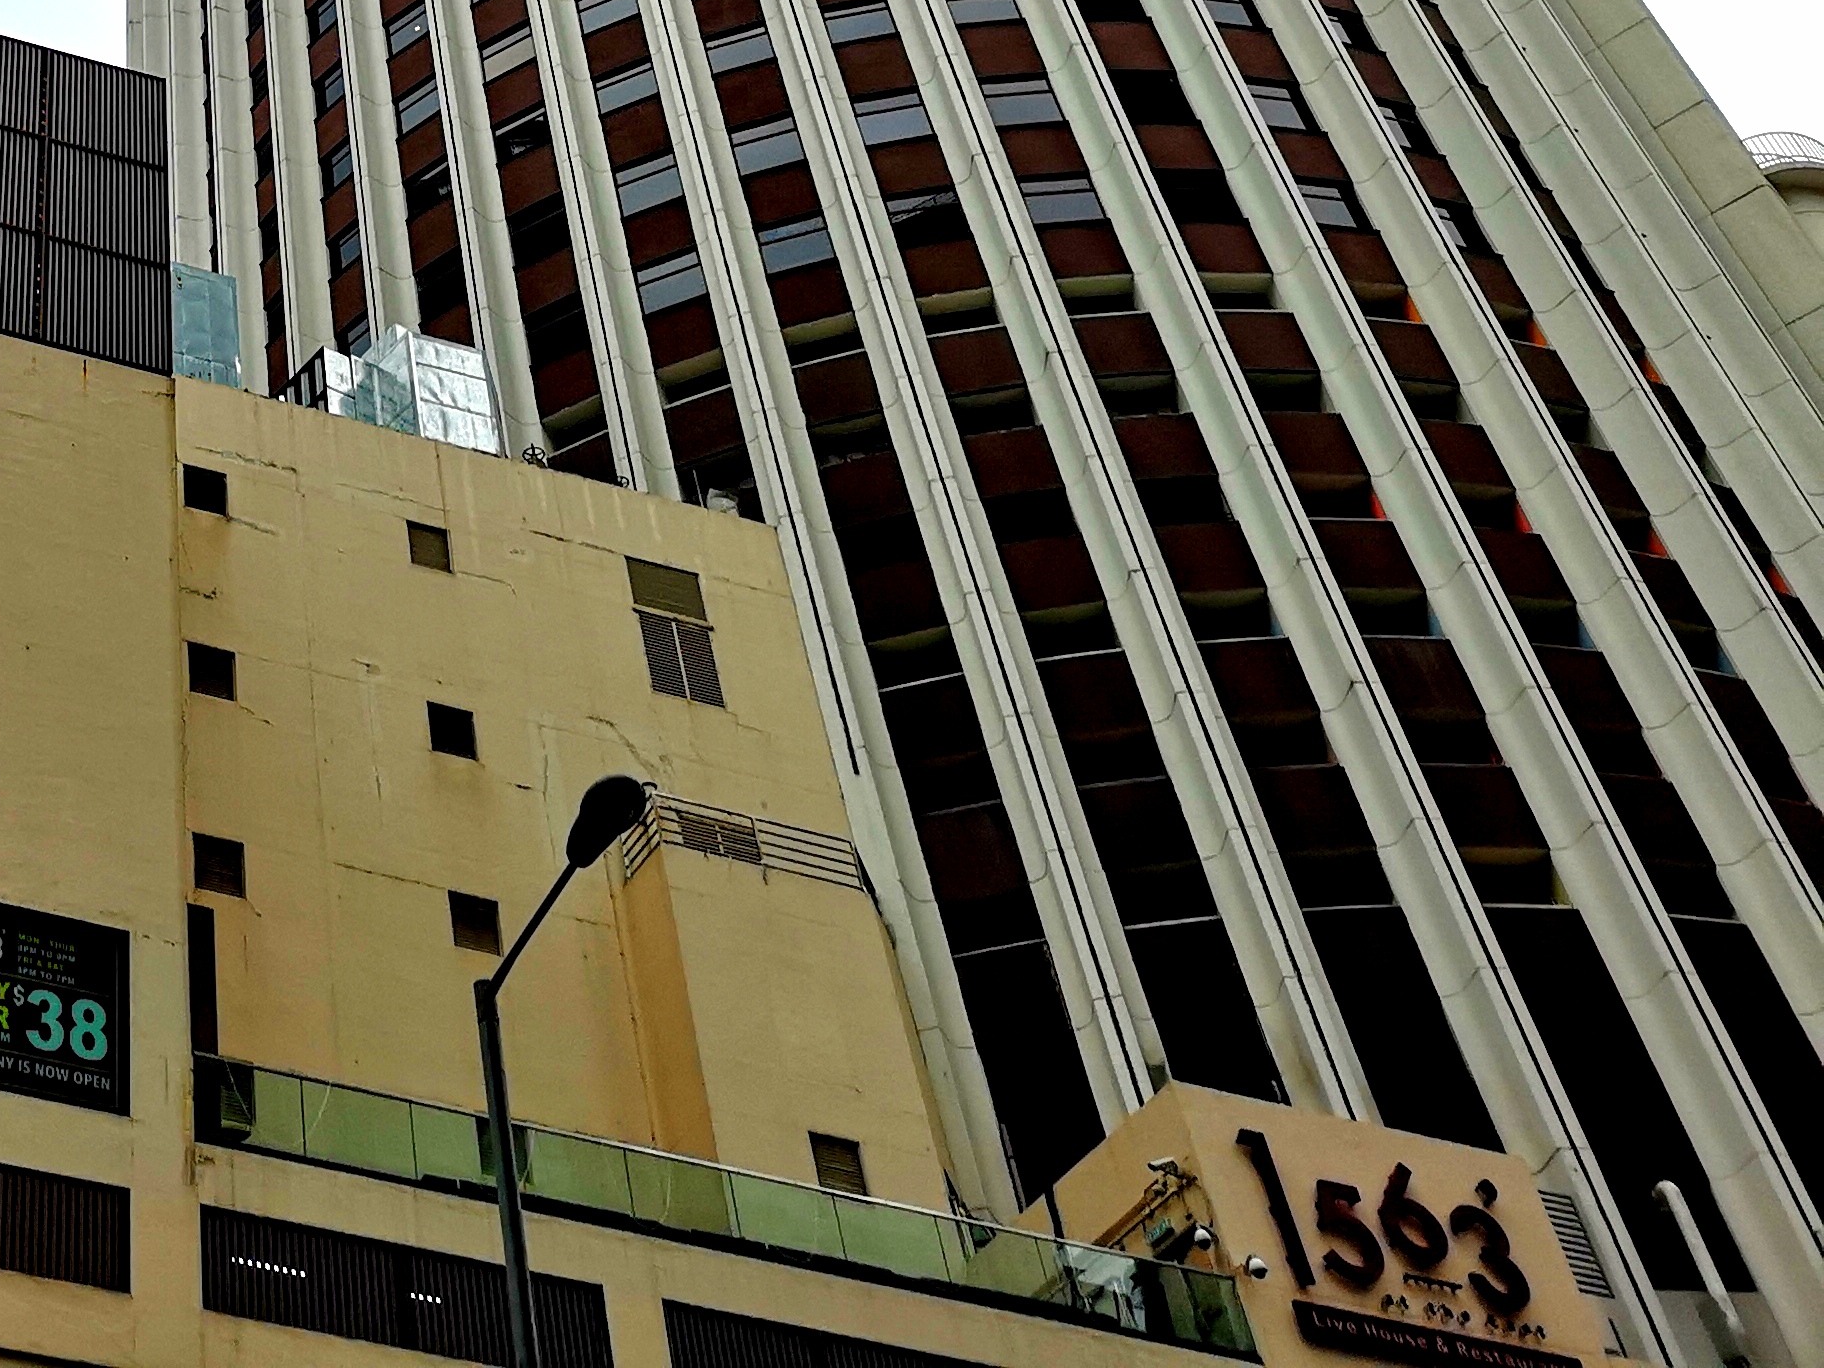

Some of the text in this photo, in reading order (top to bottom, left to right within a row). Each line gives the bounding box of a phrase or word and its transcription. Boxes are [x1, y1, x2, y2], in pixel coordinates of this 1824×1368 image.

[40, 970, 53, 980] TO
[18, 1059, 31, 1074] IS
[35, 1062, 70, 1082] NOW
[73, 1071, 111, 1091] OPEN
[1312, 1310, 1357, 1334] Live
[1363, 1322, 1428, 1349] House
[1436, 1335, 1449, 1353] &
